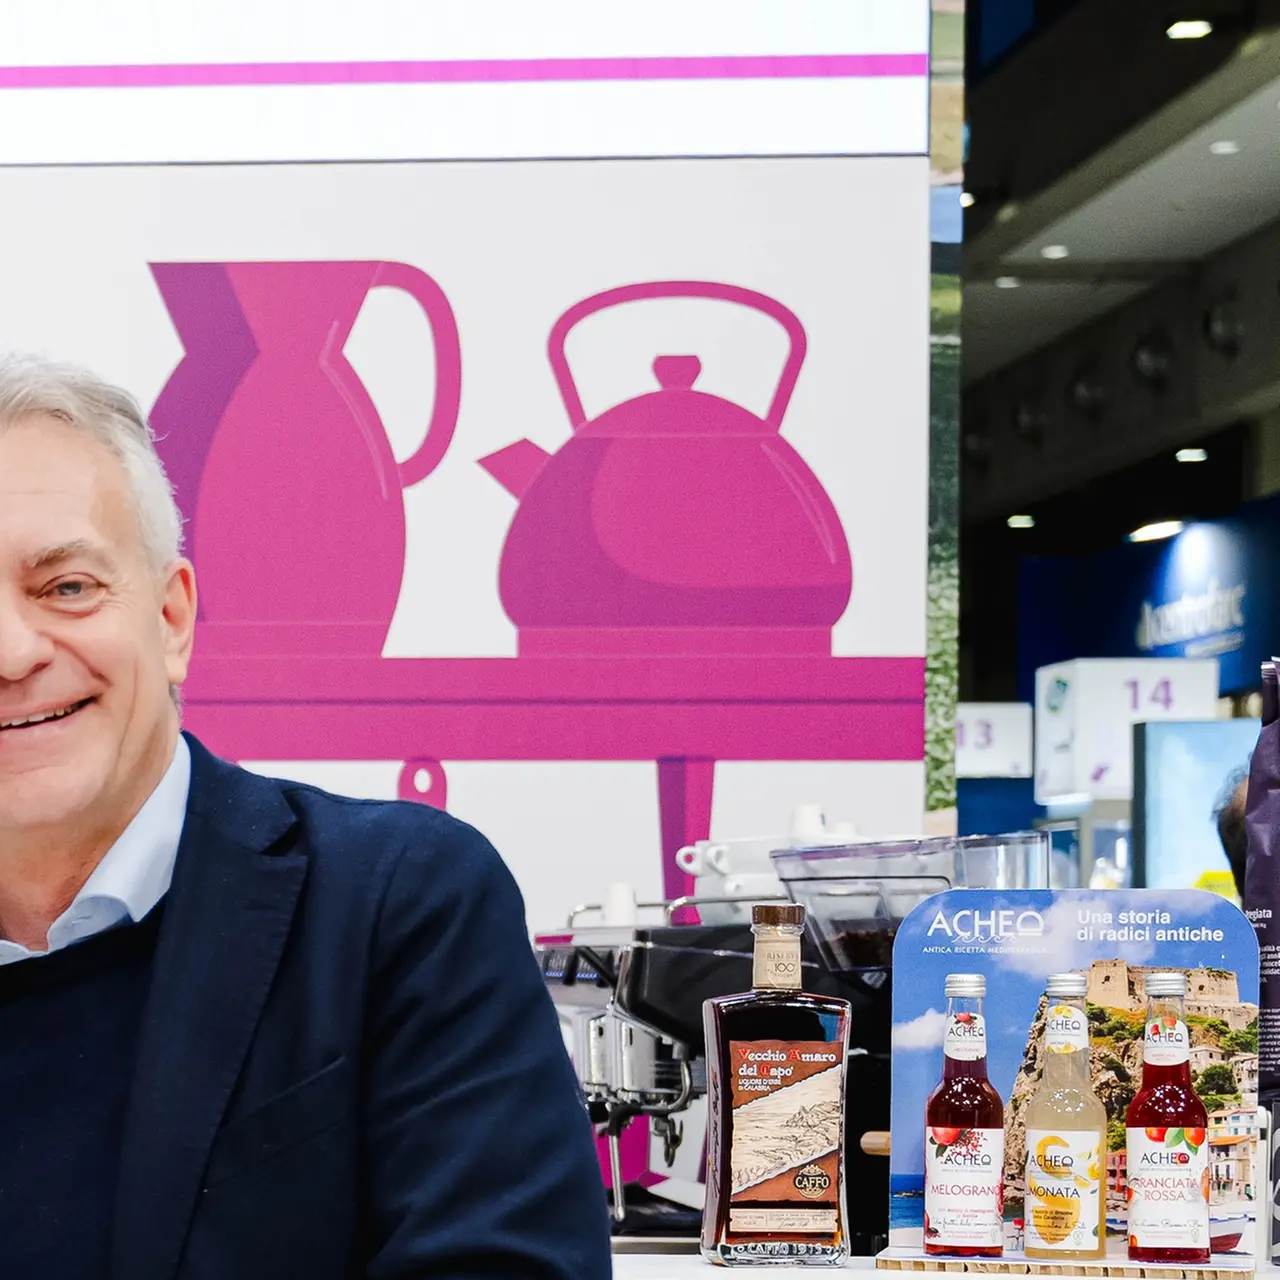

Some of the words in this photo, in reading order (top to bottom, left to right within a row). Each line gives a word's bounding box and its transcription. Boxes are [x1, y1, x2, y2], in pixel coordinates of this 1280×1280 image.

[1125, 677, 1173, 710] 14
[1077, 909, 1113, 925] Una
[1119, 909, 1171, 925] storia
[1076, 926, 1096, 942] di
[1099, 926, 1150, 942] radici
[1155, 926, 1224, 942] antiche
[738, 1048, 786, 1061] Vecchio
[788, 1048, 836, 1062] Amaro
[738, 1064, 757, 1076] del
[760, 1063, 793, 1078] Capo
[795, 1176, 830, 1189] CAFFO
[1134, 1177, 1199, 1189] ARANCIATA
[931, 1184, 1001, 1196] MELOGRANO
[1144, 1189, 1185, 1201] ROSSA
